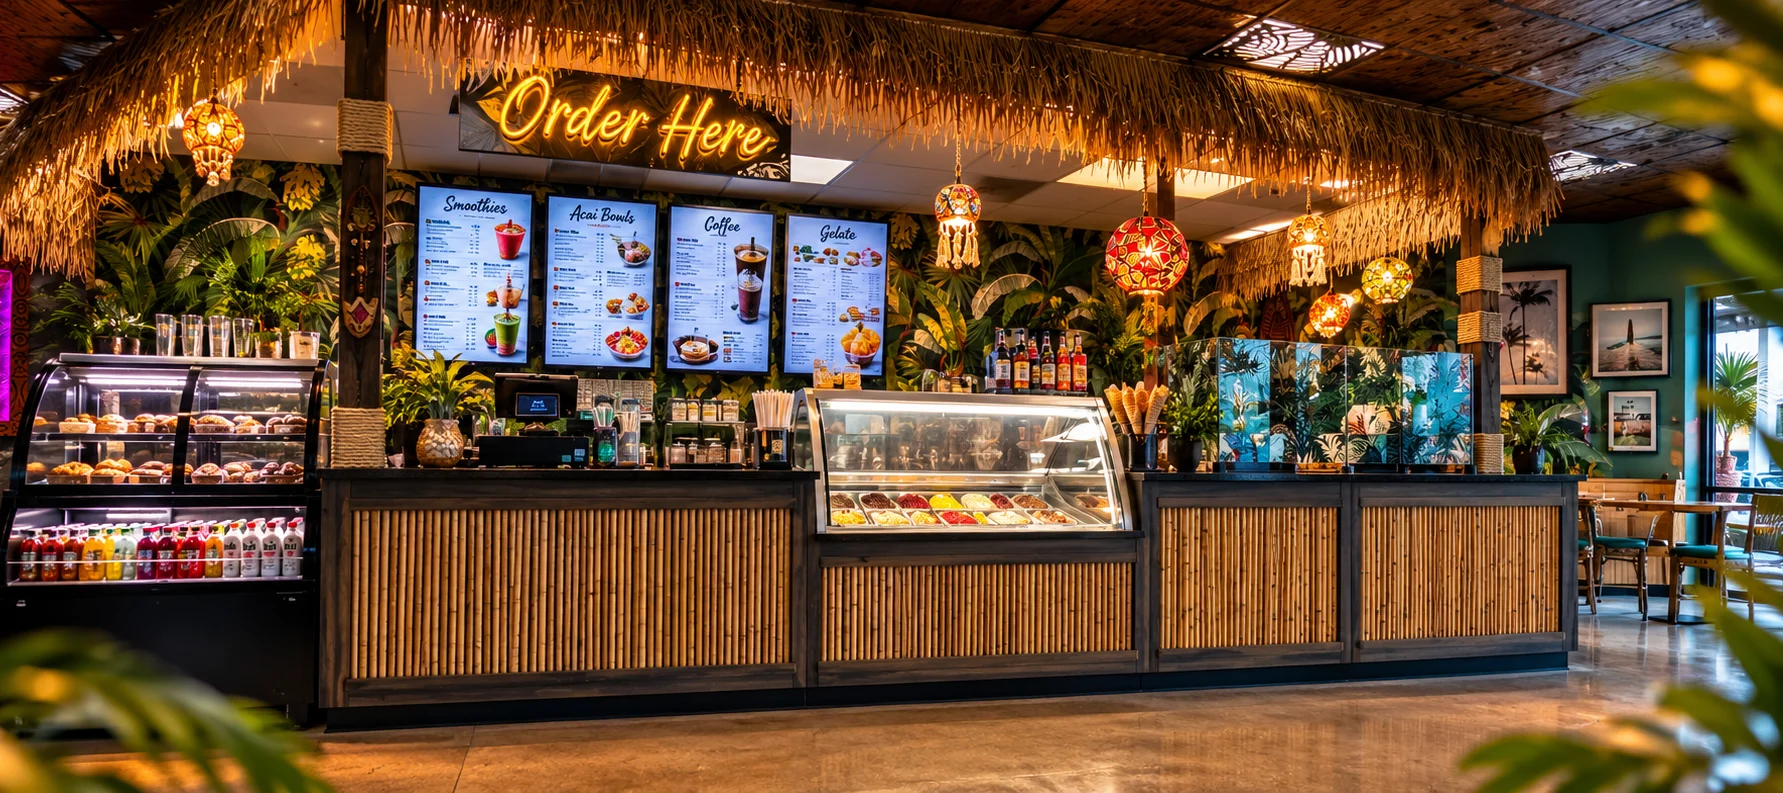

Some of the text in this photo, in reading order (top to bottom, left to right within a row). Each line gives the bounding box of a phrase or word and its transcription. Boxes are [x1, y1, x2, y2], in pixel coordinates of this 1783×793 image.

[500, 75, 775, 162] Order Here
[443, 195, 508, 215] Smoothies
[569, 204, 636, 224] Acai Bowls
[704, 215, 741, 237] Coffee
[820, 224, 857, 243] Gelate
